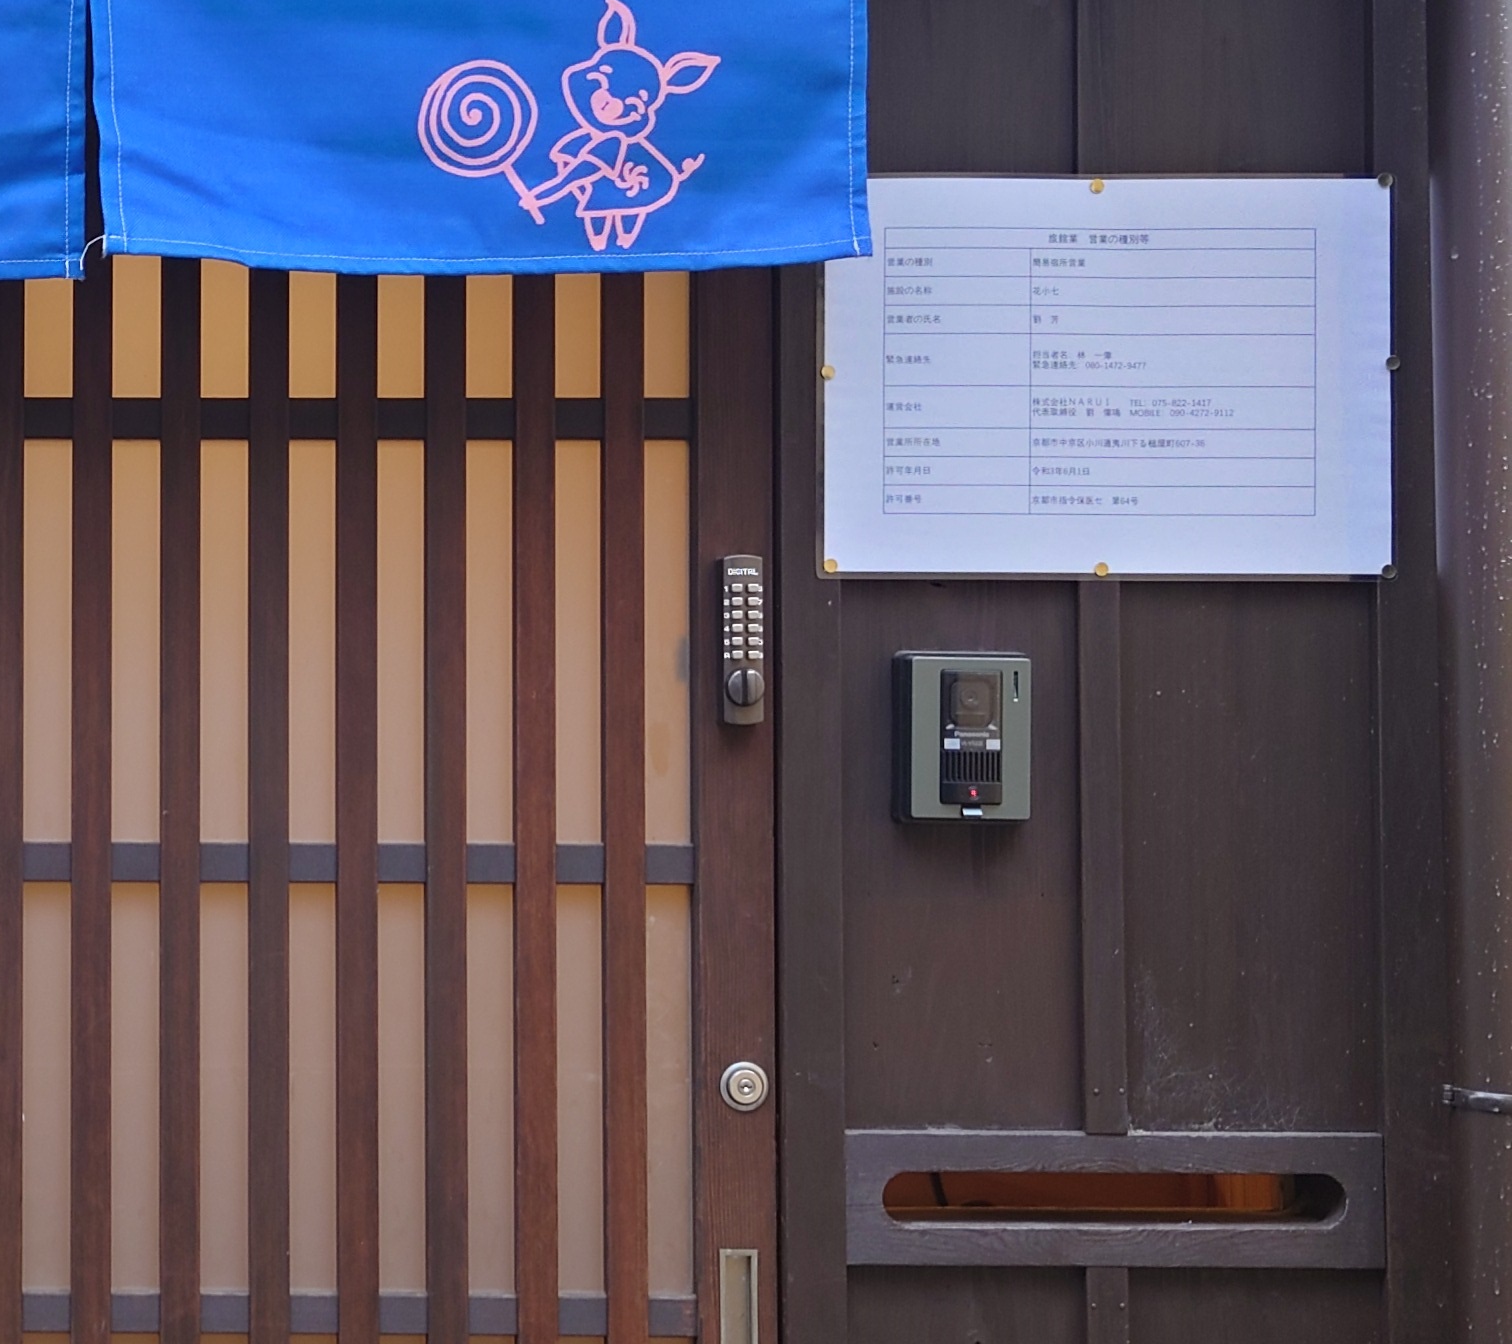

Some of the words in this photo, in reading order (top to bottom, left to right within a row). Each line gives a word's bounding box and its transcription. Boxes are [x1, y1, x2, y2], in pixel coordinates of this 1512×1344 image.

[1089, 234, 1149, 245] 営業の種別等
[887, 257, 933, 267] 営業の種別
[1032, 258, 1086, 268] 簡易宿所営業
[886, 286, 933, 296] 施設の名称
[1032, 286, 1060, 296] 花小七
[886, 314, 941, 324] 営業者の氏名
[886, 355, 931, 365] 緊急連絡先
[886, 402, 922, 411] 運営会社
[886, 438, 941, 446] 営業所所在地
[885, 466, 931, 475] 許可年月日
[885, 495, 923, 504] 許可番号
